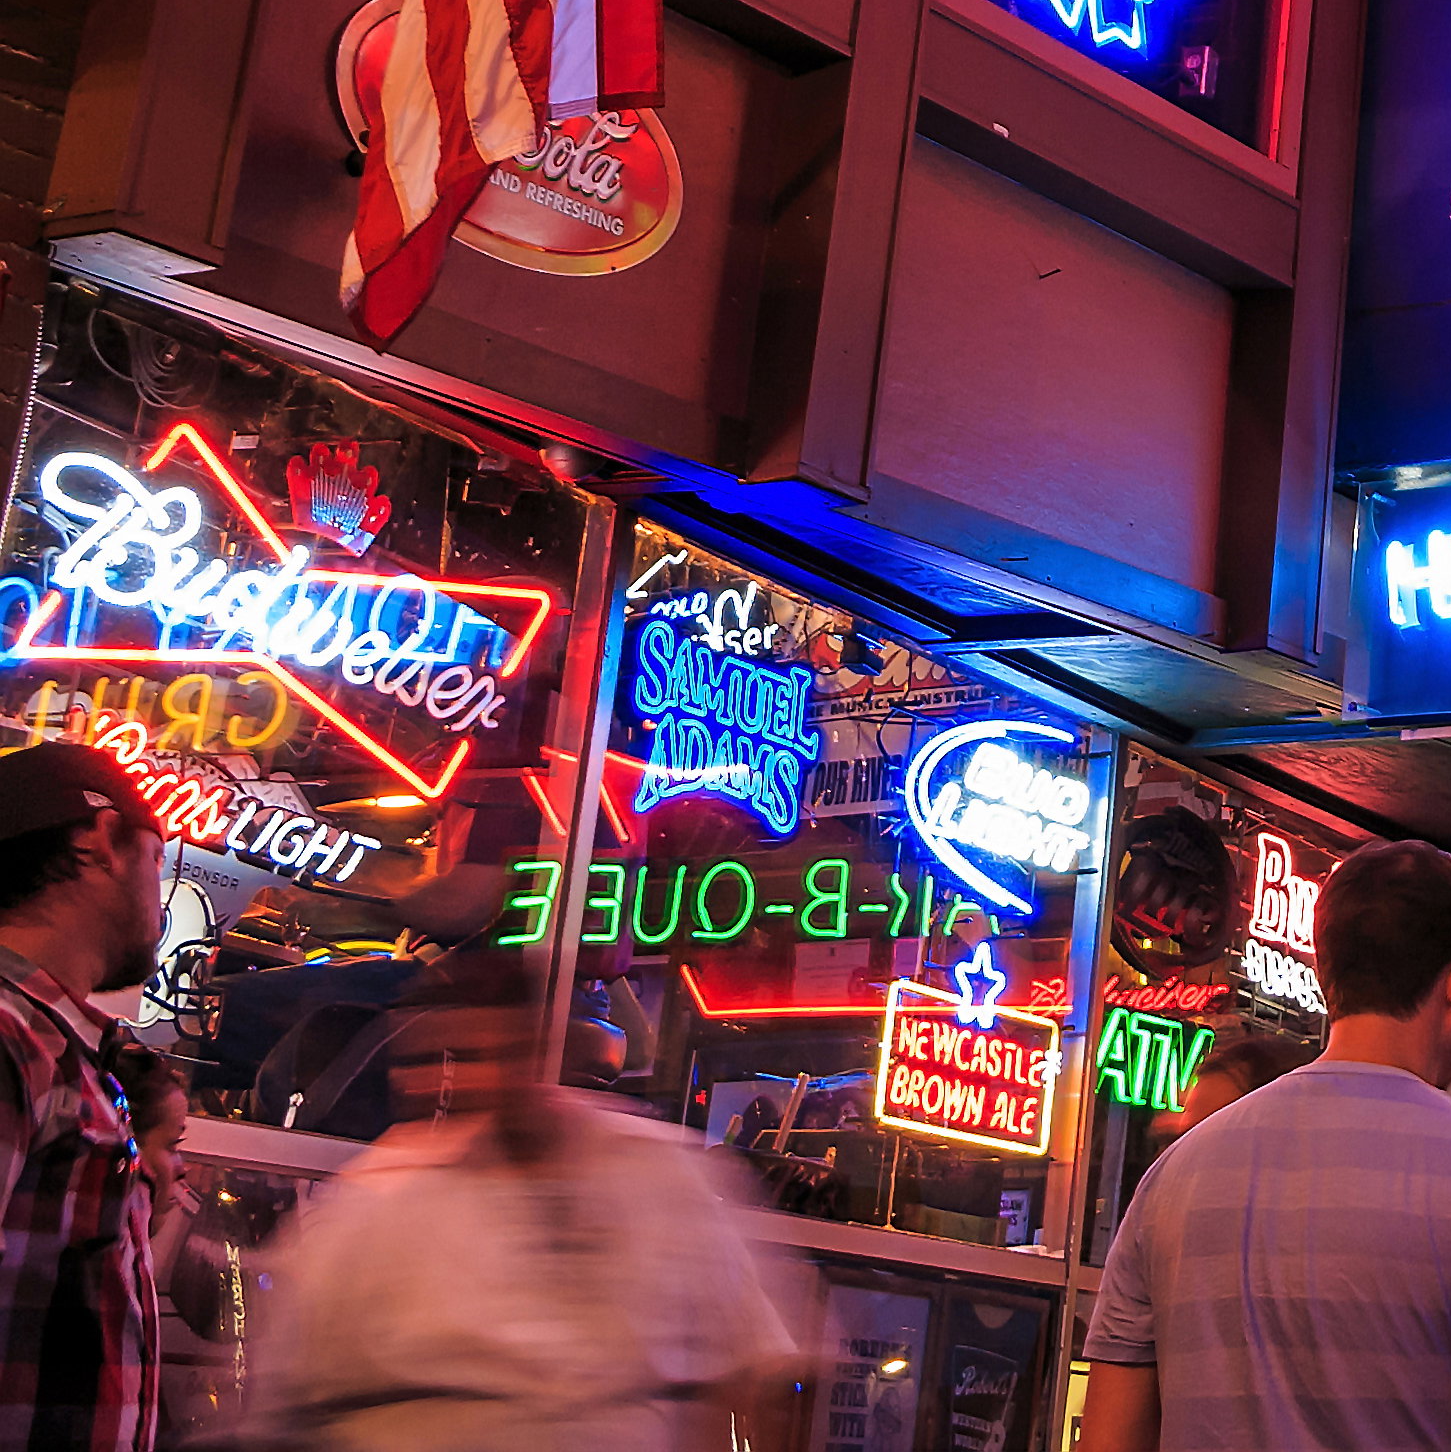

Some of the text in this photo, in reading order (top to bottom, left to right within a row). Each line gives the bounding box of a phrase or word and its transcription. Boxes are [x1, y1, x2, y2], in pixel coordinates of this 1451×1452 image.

[525, 181, 624, 237] REFRESHING
[40, 451, 500, 732] Budweiser
[635, 620, 819, 761] SAMUEL
[634, 712, 799, 834] ADAMS
[226, 800, 382, 882] LIGHT
[898, 1015, 1046, 1088] NEWCASTLE
[889, 1064, 1039, 1136] BROWN ALE
